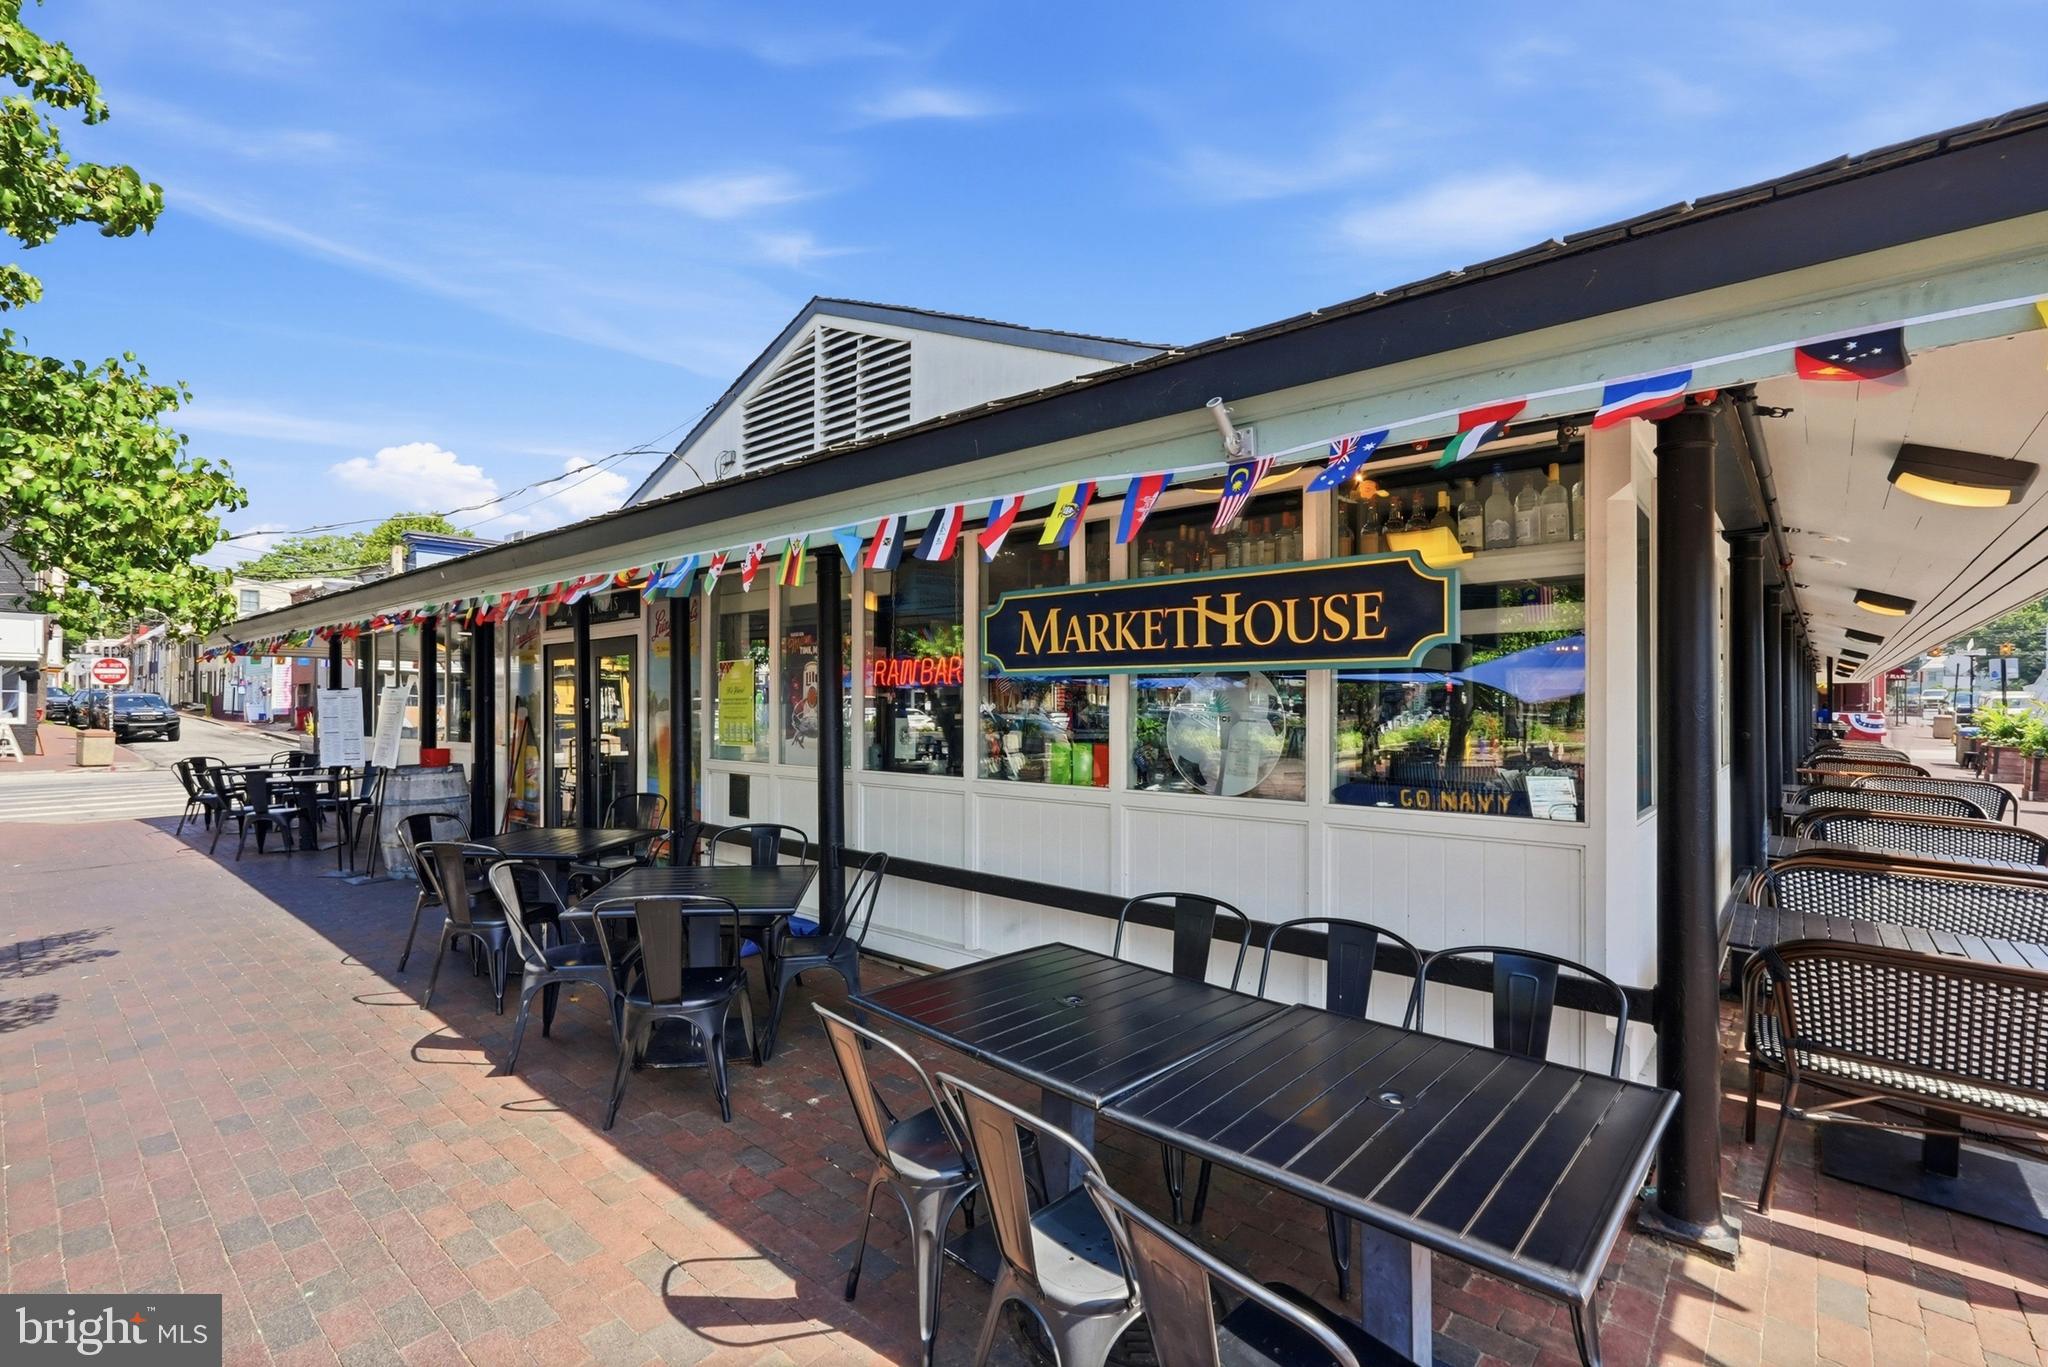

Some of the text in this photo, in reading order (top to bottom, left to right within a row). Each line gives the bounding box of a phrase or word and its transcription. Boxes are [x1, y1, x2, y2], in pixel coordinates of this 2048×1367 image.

[873, 656, 964, 686] RAW BAR
[1400, 788, 1430, 809] GO
[1439, 790, 1513, 814] NAVY
